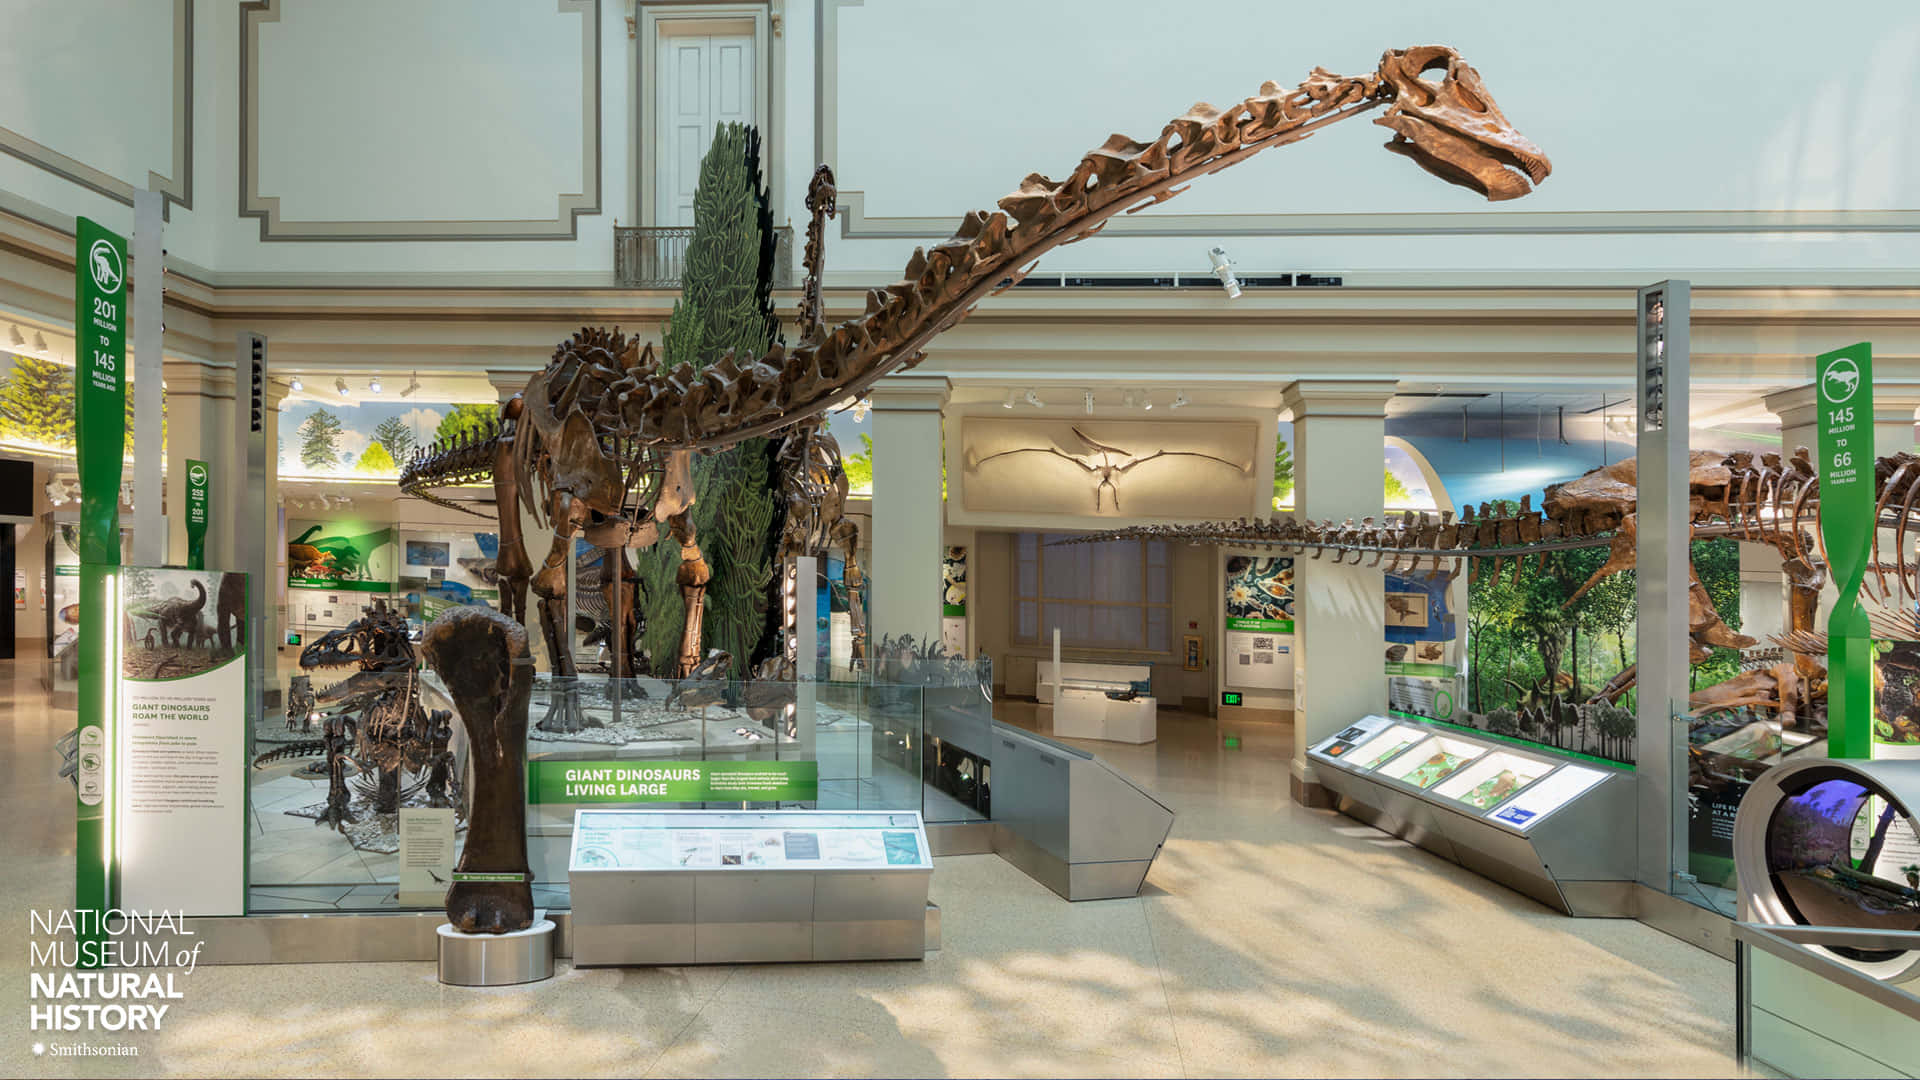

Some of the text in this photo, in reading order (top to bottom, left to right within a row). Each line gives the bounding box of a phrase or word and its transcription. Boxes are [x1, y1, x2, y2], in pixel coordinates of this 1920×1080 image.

[93, 296, 116, 321] 201
[93, 317, 117, 332] MILLION
[100, 335, 110, 346] TO
[93, 350, 115, 371] 145
[92, 369, 116, 384] MILLION
[1828, 407, 1854, 424] 145
[1828, 424, 1855, 434] MILLION
[1836, 439, 1847, 447] TO
[1833, 452, 1852, 467] 66
[1830, 469, 1856, 478] MILLION
[1225, 694, 1238, 704] EXIT
[132, 703, 211, 712] GIANT DINOSAURS
[178, 713, 209, 721] WORLD
[565, 769, 613, 781] GIANT
[616, 769, 701, 781] DINOSAURS
[565, 783, 668, 796] LIVING LARGE
